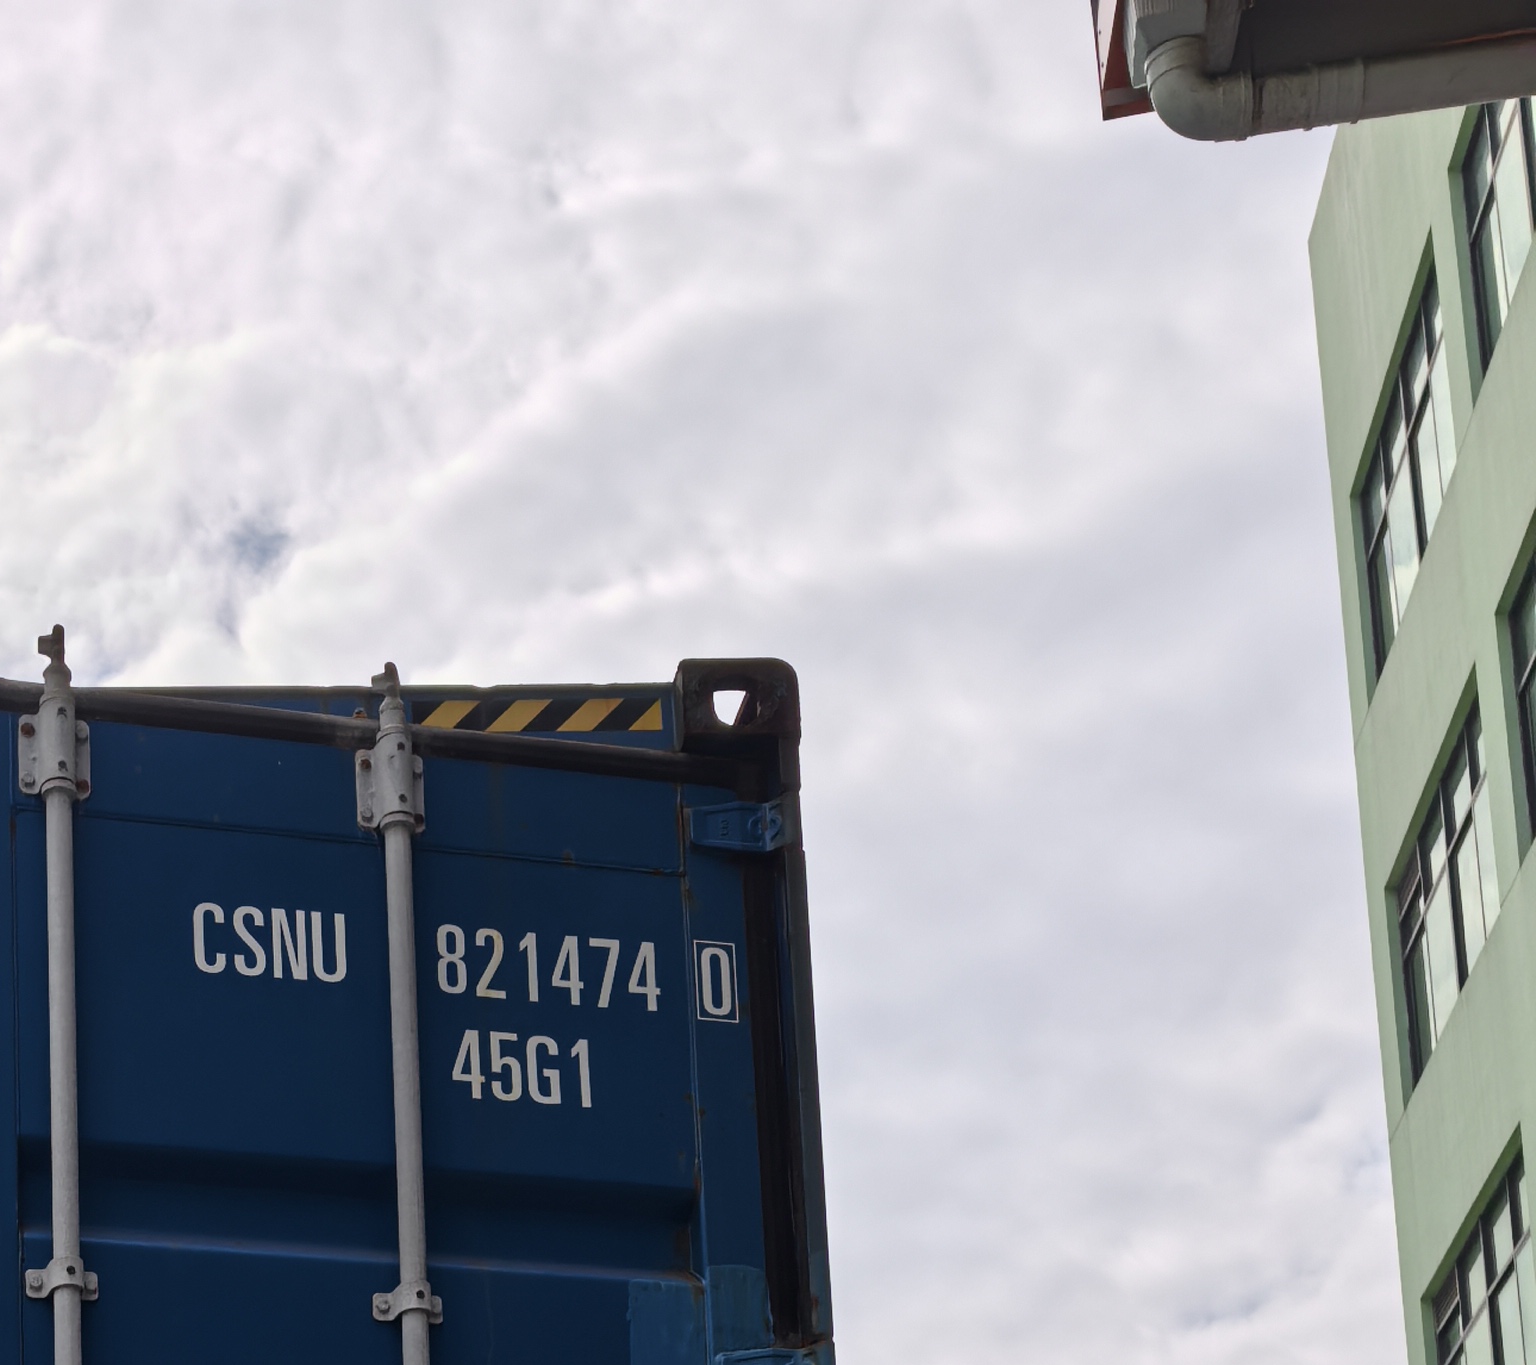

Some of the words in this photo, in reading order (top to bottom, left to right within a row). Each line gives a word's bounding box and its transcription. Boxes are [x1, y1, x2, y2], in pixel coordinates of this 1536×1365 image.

[192, 902, 347, 983] CSNU
[436, 923, 661, 1012] 821474
[700, 947, 732, 1016] 0
[452, 1029, 592, 1108] 45G1
